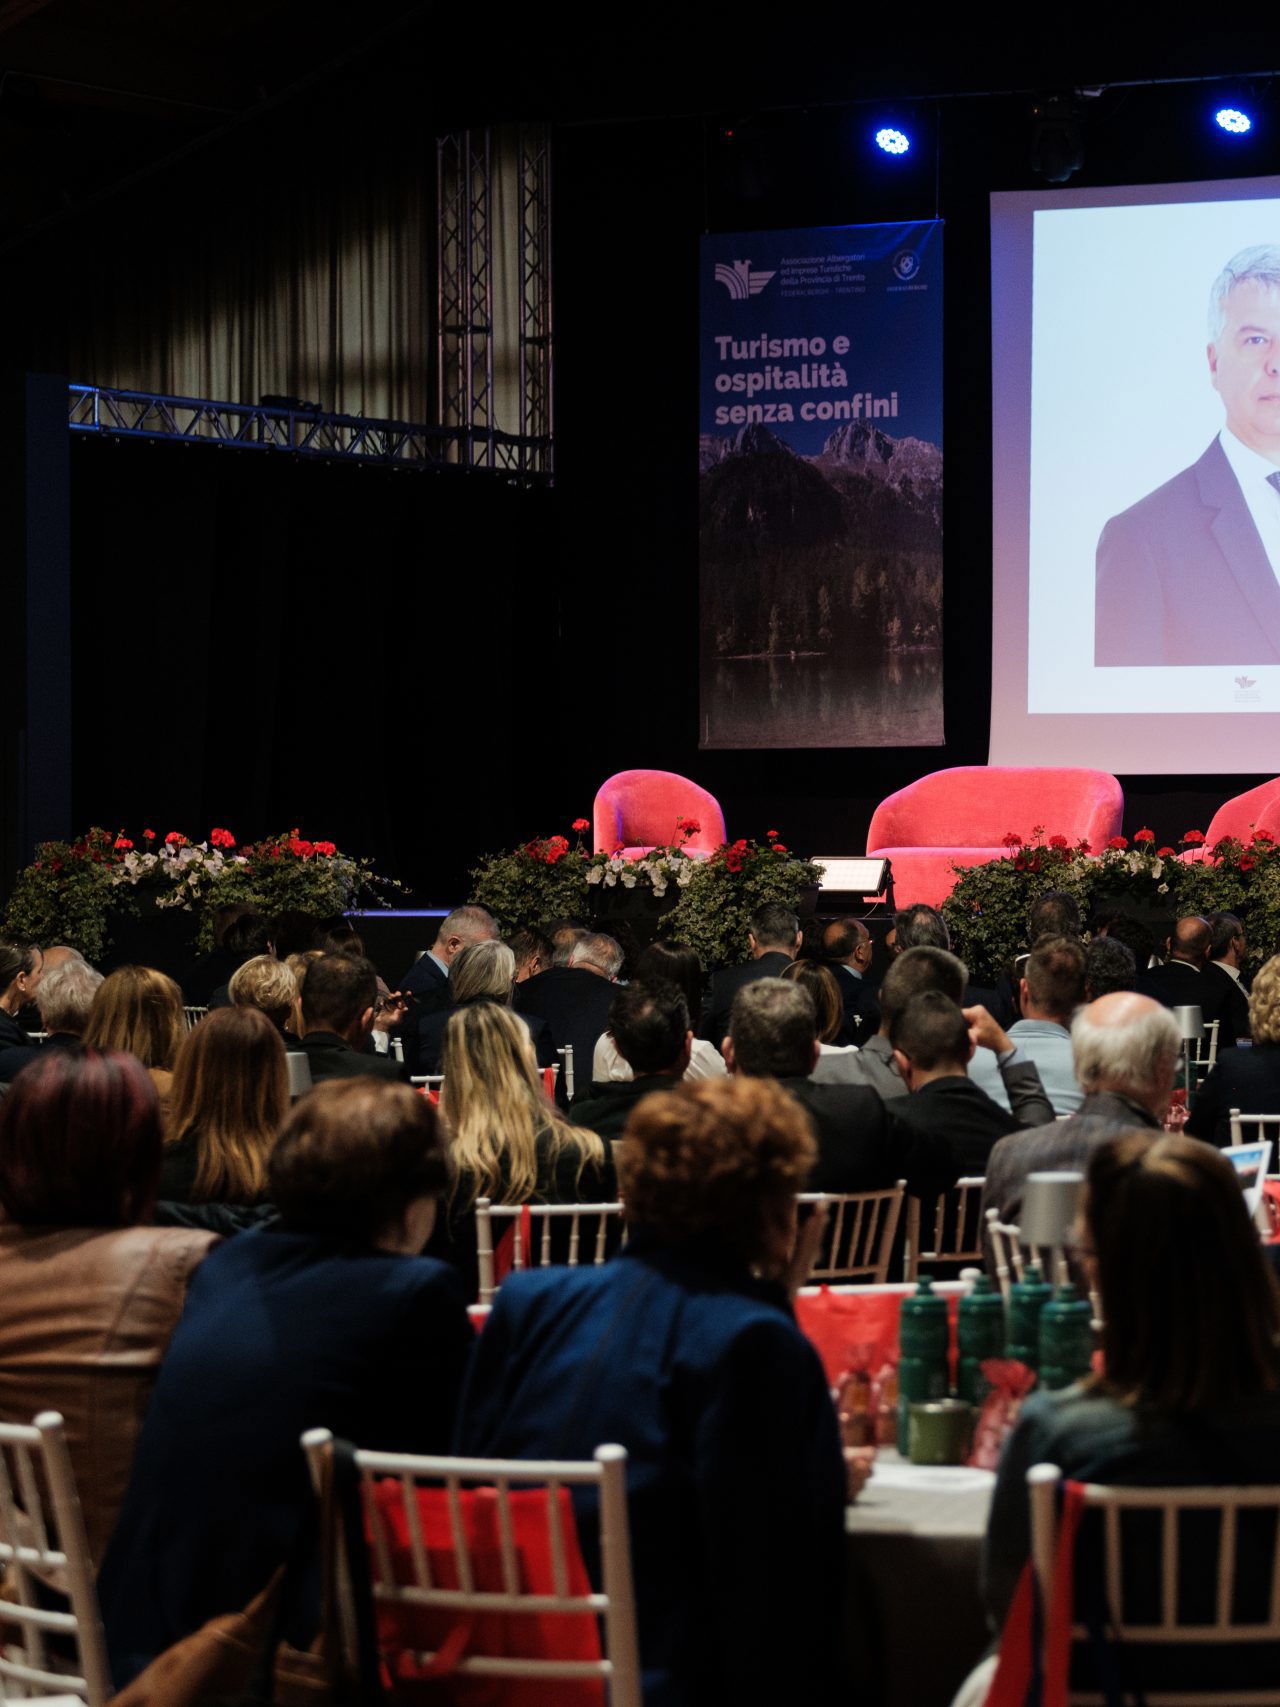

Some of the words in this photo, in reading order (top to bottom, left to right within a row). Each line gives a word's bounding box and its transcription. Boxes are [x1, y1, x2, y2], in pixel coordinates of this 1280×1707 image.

[826, 253, 866, 265] Albergatori
[780, 276, 800, 287] della
[800, 274, 833, 285] Provincia
[834, 273, 841, 283] di
[842, 272, 866, 283] Trento
[714, 333, 827, 361] Turismo
[832, 335, 850, 355] e
[715, 361, 848, 398] ospitalità
[715, 402, 795, 425] senza
[800, 391, 899, 422] confini
